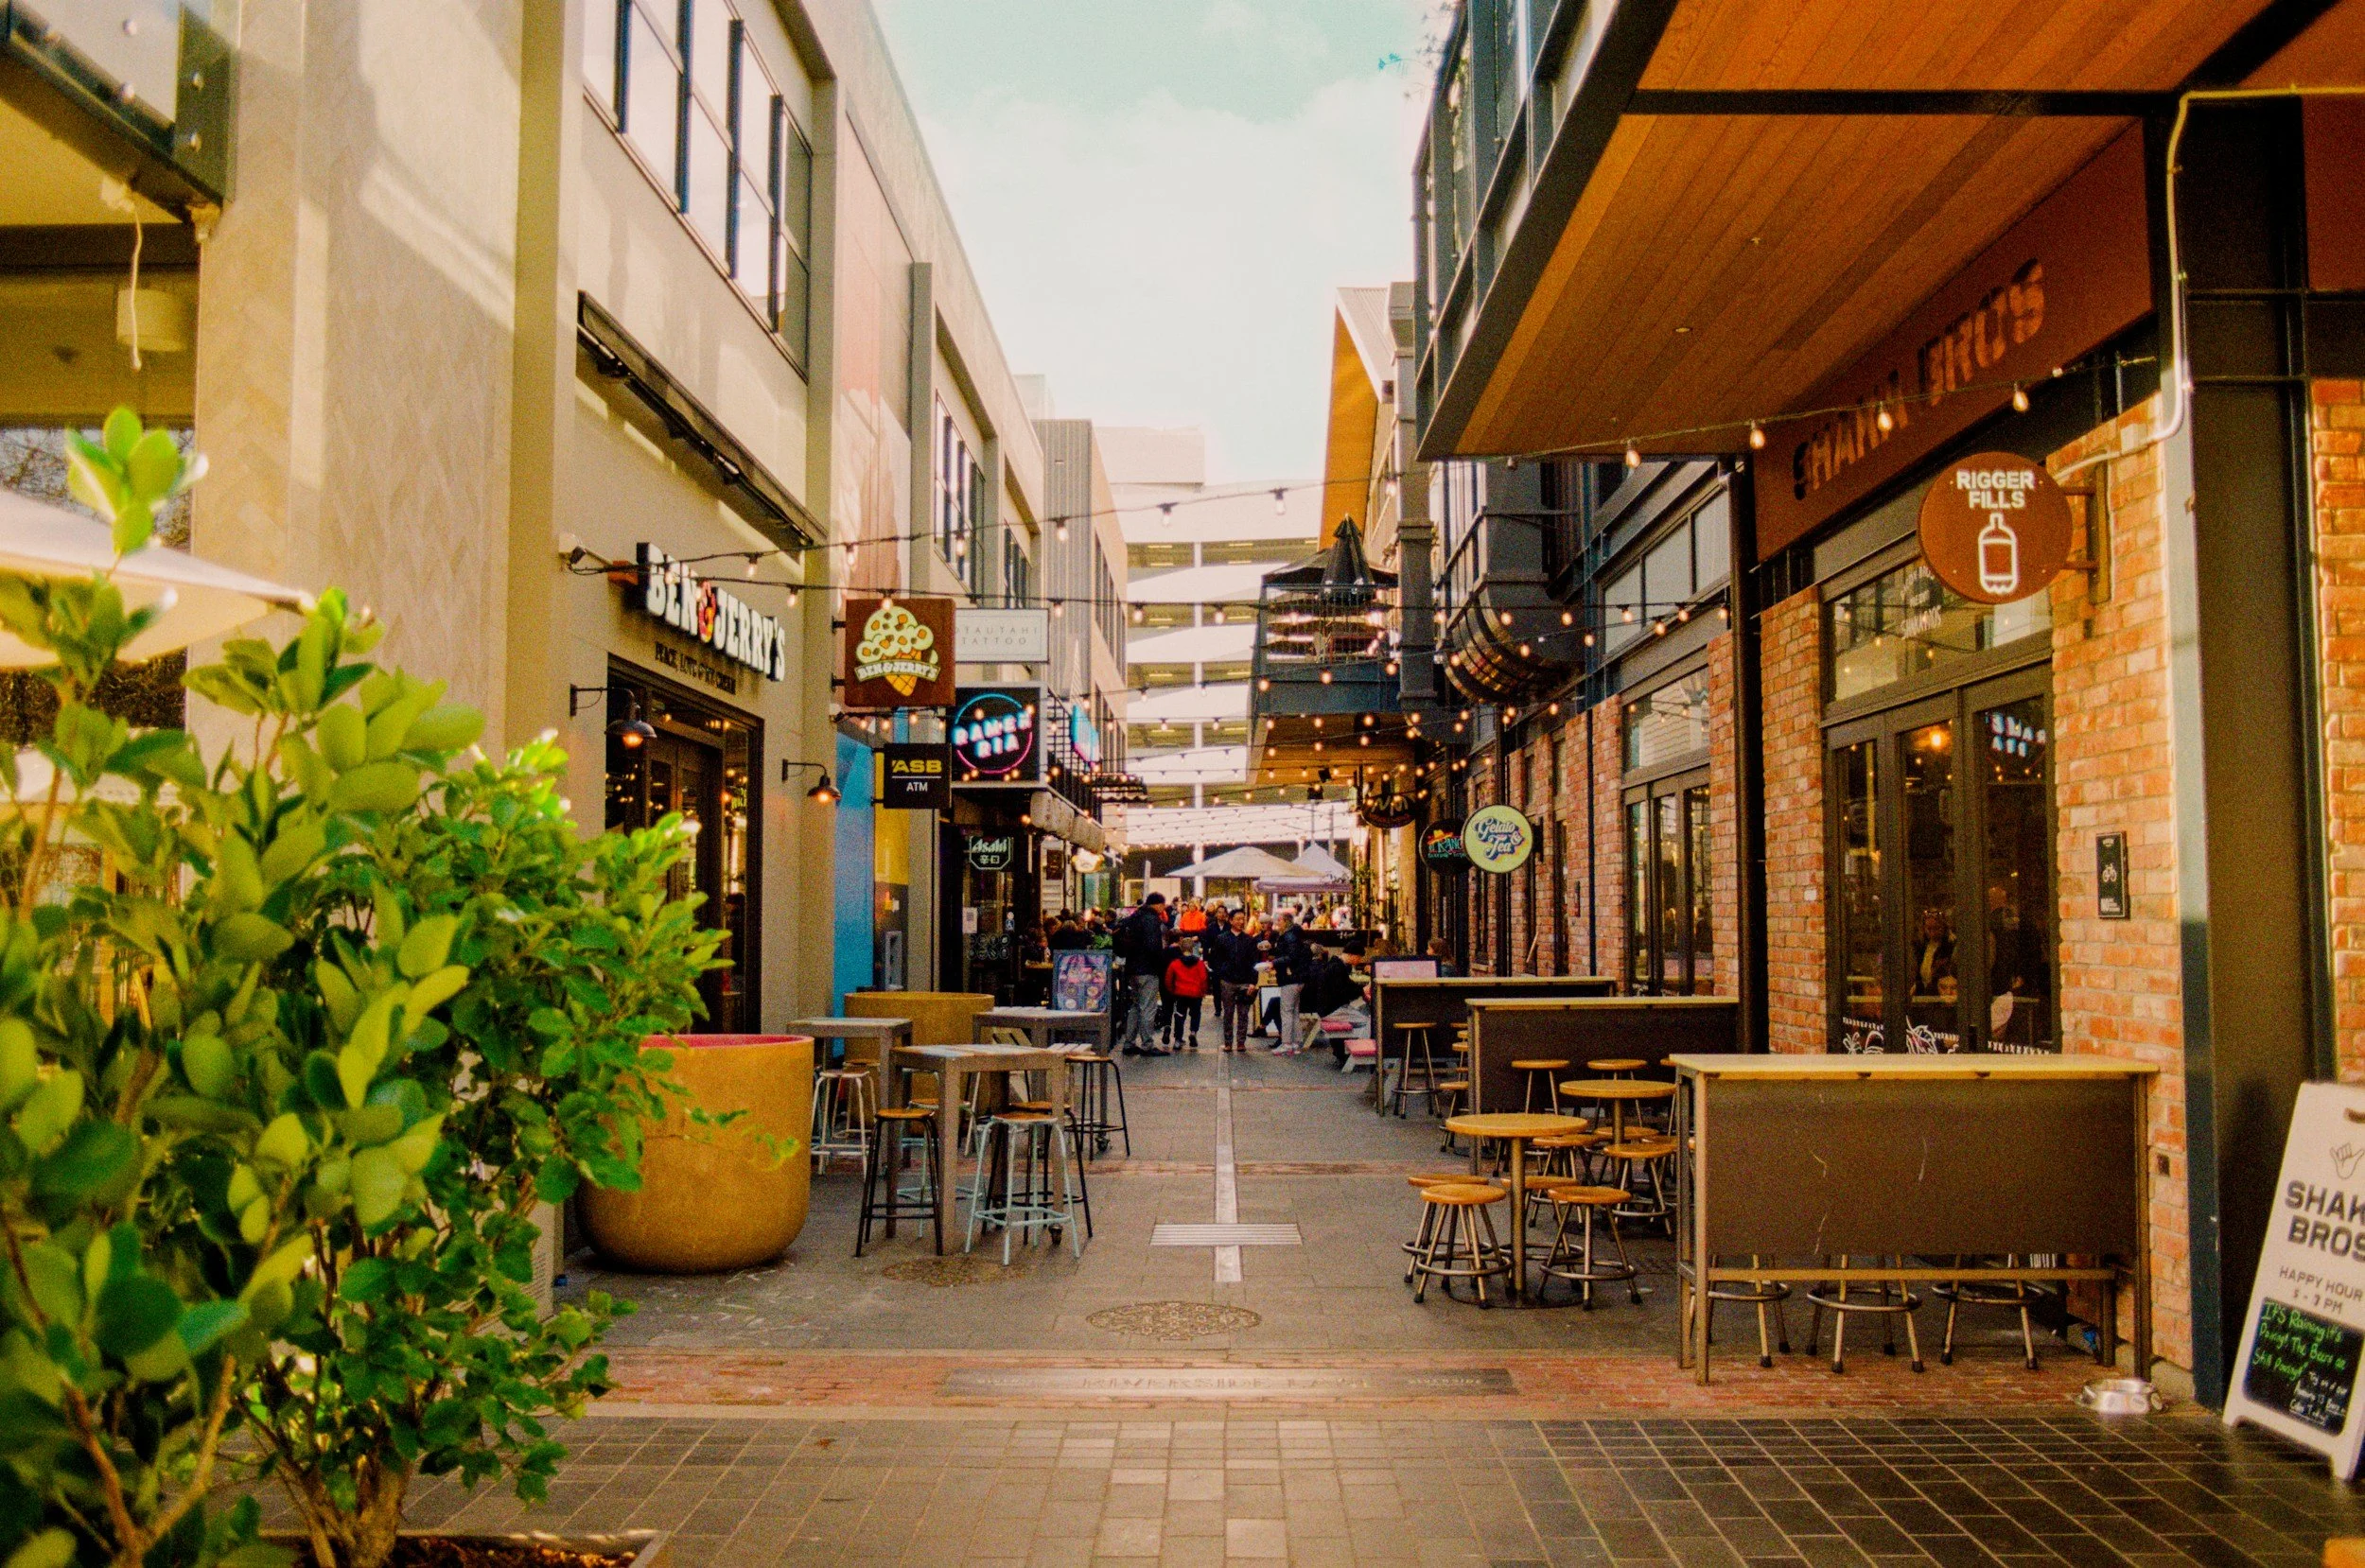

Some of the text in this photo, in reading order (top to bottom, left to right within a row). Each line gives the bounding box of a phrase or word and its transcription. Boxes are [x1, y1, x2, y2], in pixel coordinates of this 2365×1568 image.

[1918, 257, 2044, 407] BROS
[1955, 469, 2036, 489] RIGGER
[1969, 490, 2025, 509] FILLS
[647, 542, 698, 636] BEN
[712, 586, 785, 682] JERRY'S
[962, 636, 1026, 645] TATTOO
[857, 662, 884, 679] BEN
[892, 661, 937, 678] JERRY'S
[951, 709, 1033, 746] RAMEN
[974, 733, 1020, 758] RIA
[892, 759, 942, 774] ASB
[906, 781, 928, 793] ATM
[1475, 816, 1517, 842] Gelato
[972, 838, 1007, 853] Asahi
[1485, 834, 1515, 860] Tea
[2279, 1265, 2363, 1302] HAPPY HOUR
[2323, 1298, 2343, 1314] PM
